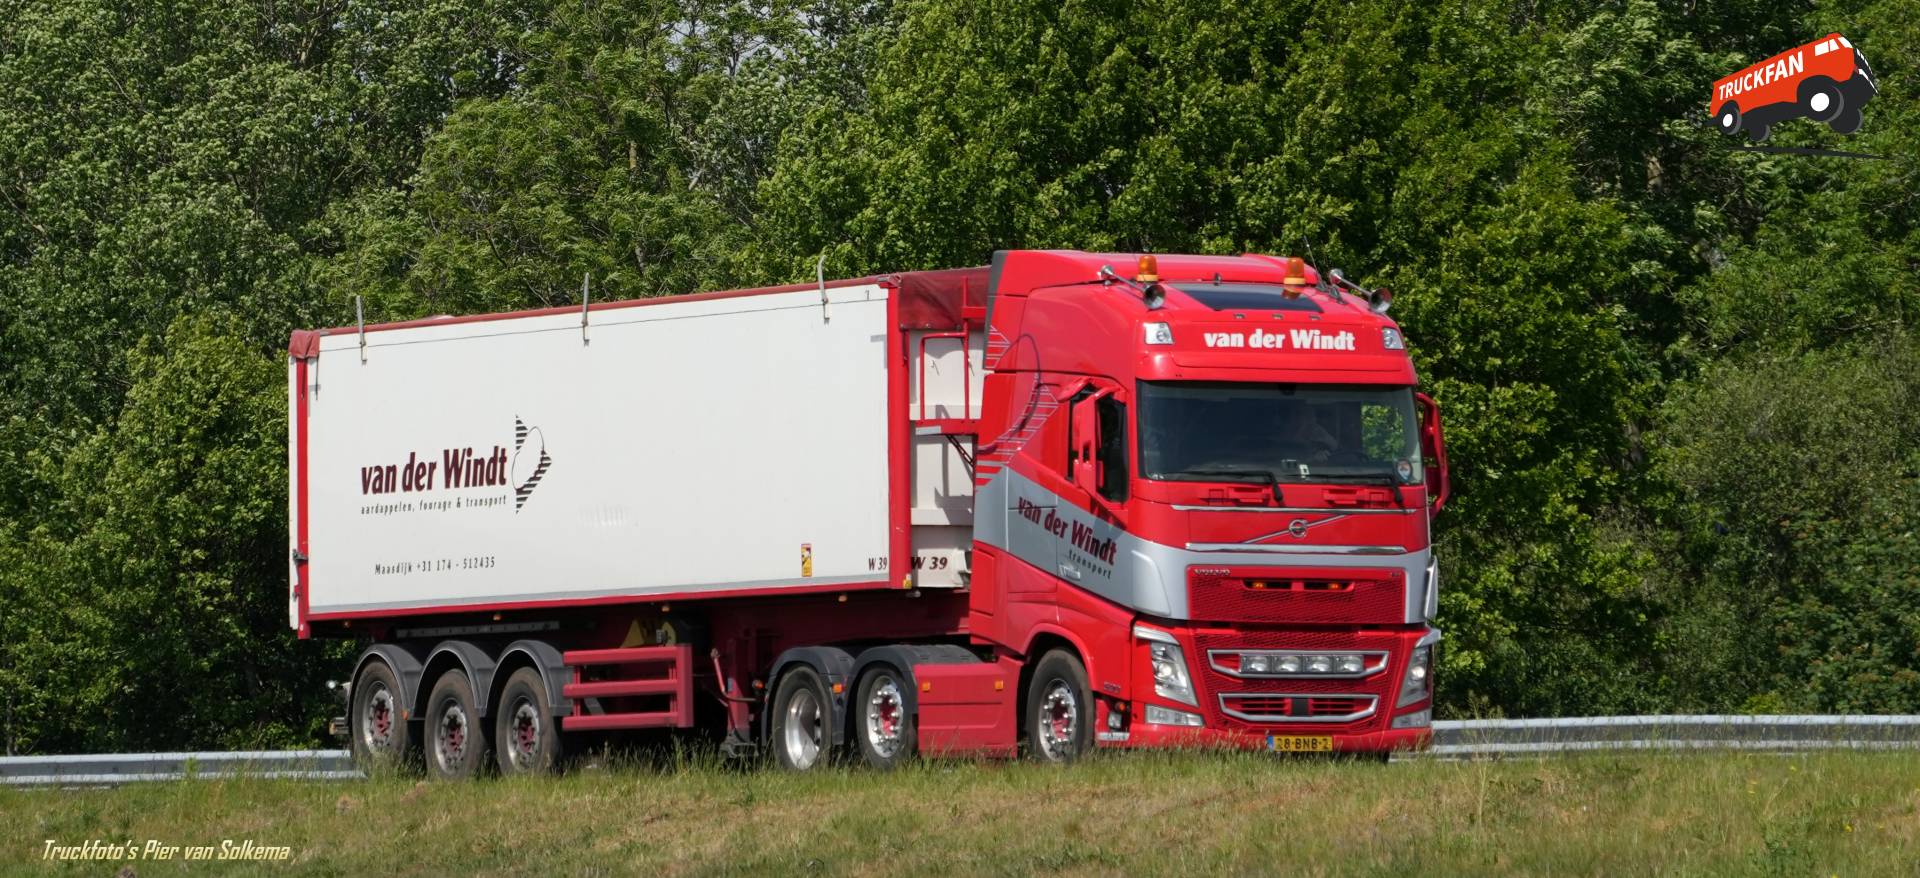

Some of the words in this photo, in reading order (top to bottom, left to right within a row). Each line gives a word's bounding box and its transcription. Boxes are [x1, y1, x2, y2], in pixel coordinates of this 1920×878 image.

[1204, 332, 1244, 348] van
[1248, 328, 1285, 349] der
[1290, 329, 1355, 351] Windt
[361, 463, 397, 495] van
[402, 451, 436, 492] der
[444, 445, 507, 489] Windt
[361, 502, 415, 516] aardappelen,
[420, 499, 451, 512] fourage
[456, 497, 461, 508] &
[466, 495, 507, 507] transport
[1018, 496, 1041, 525] van
[1044, 508, 1068, 539] der
[1071, 519, 1117, 566] Windt
[375, 562, 412, 576] Maasdijk
[417, 560, 431, 572] +31
[437, 559, 451, 571] 174
[463, 556, 495, 569] 512435
[868, 557, 876, 571] W
[878, 556, 888, 570] 39
[911, 556, 926, 570] W
[929, 556, 948, 570] 39
[1069, 549, 1111, 579] transport
